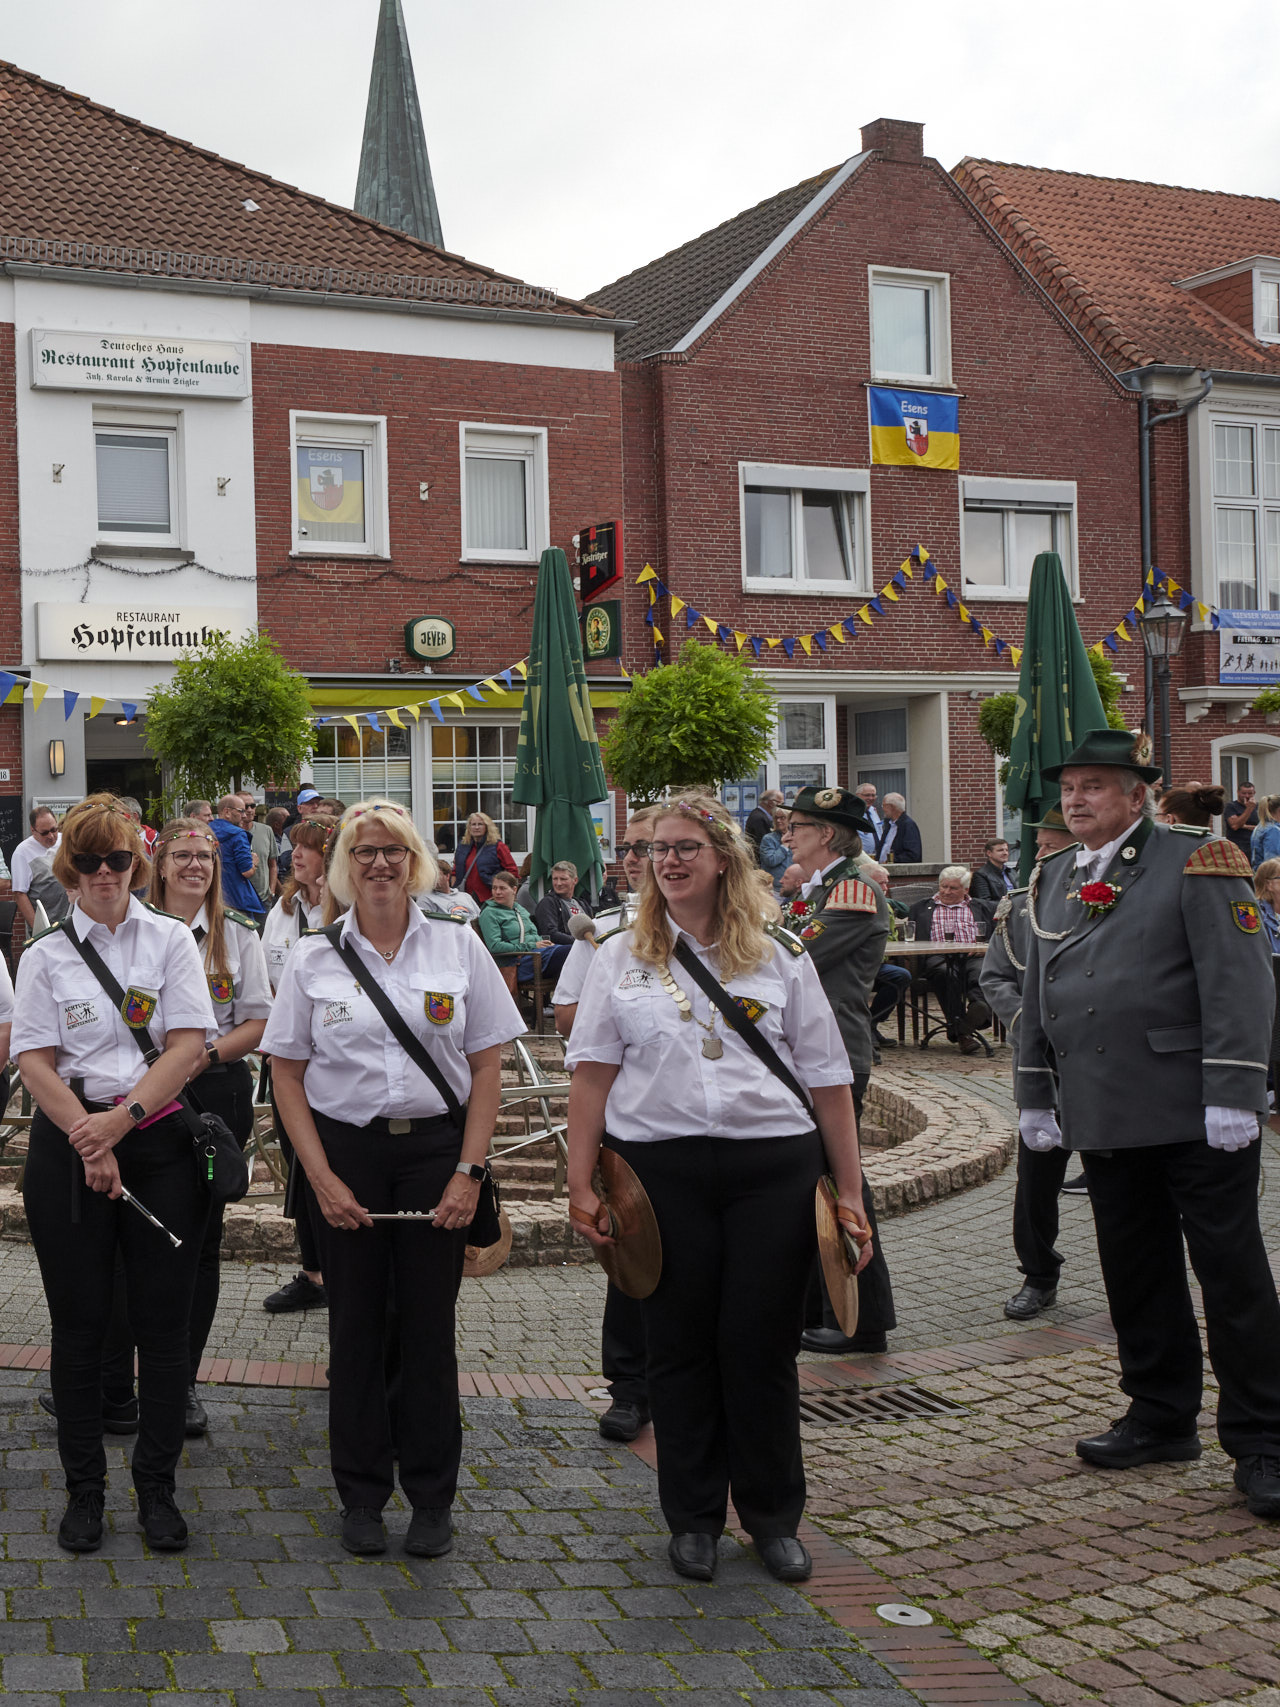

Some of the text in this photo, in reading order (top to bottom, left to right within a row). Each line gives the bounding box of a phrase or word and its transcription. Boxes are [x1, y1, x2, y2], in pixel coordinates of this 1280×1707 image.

[100, 339, 184, 354] Deutsches Haus
[41, 349, 240, 376] Restaurant Hopfenlaube
[901, 400, 928, 415] Esens
[308, 449, 343, 462] Esens
[116, 612, 181, 623] RESTAURANT
[421, 631, 447, 646] JEVER
[0, 771, 7, 779] 18
[64, 1002, 91, 1013] ACHTUNG
